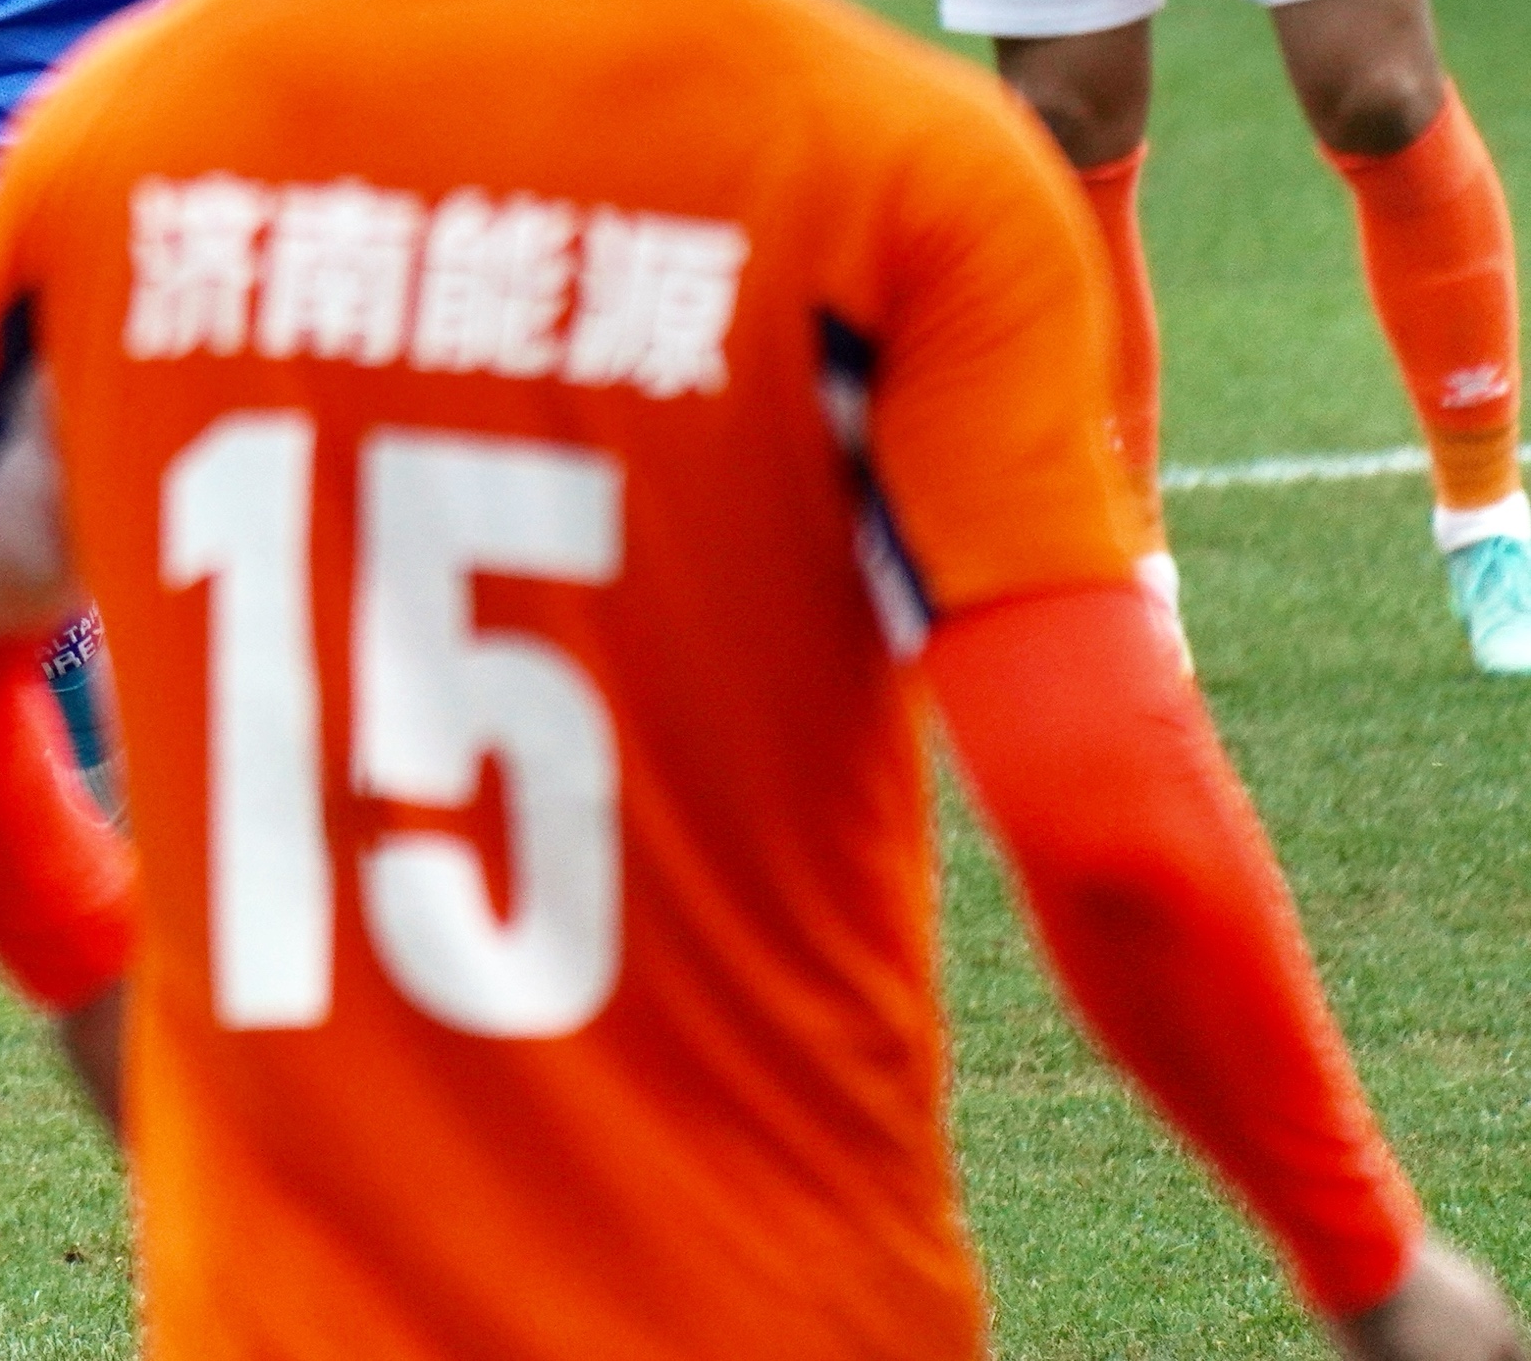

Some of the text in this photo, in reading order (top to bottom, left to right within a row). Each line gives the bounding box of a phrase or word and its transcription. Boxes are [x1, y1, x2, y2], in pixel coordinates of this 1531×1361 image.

[124, 171, 749, 398] 济南能源
[159, 408, 628, 1041] 15
